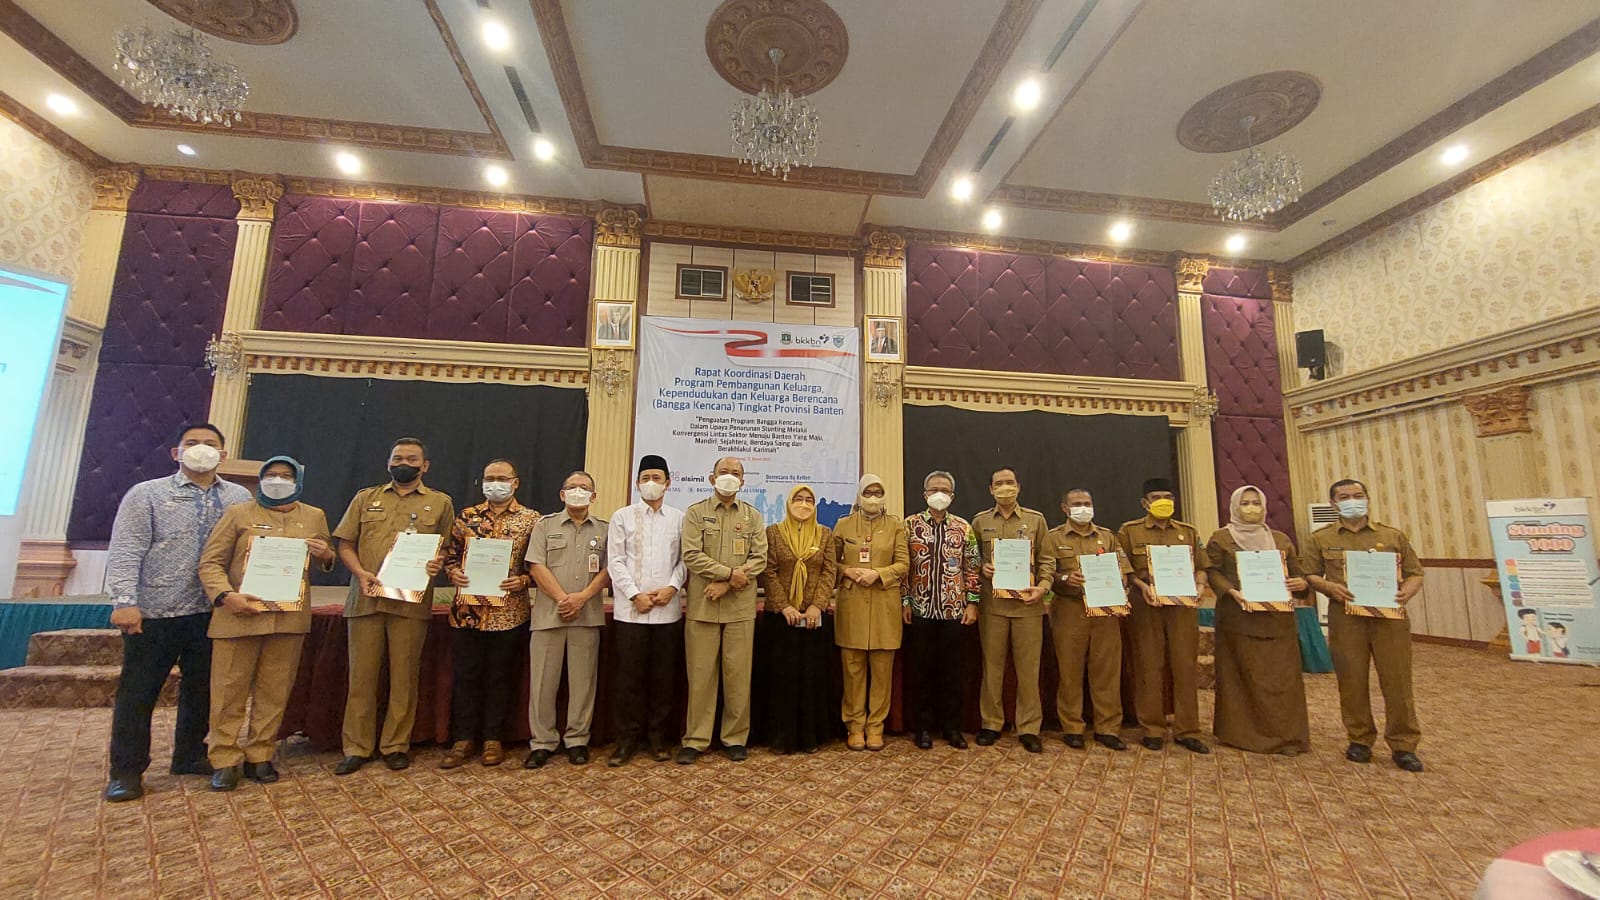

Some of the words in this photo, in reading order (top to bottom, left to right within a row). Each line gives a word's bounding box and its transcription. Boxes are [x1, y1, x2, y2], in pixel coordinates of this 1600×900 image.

[796, 336, 821, 345] bkkbn
[695, 367, 721, 379] Rapat
[724, 368, 772, 380] Koordinasi
[774, 371, 806, 381] Daerah
[674, 377, 714, 389] Program
[717, 379, 780, 391] Pembangunan
[783, 382, 824, 394] Keluarga,
[659, 388, 728, 400] Kependudukan
[731, 391, 748, 401] dan
[750, 391, 790, 403] Keluarga
[792, 394, 838, 404] Berencana
[652, 399, 690, 411] (Bangga
[693, 400, 735, 412] Kencana)
[738, 402, 772, 415] Tingkat
[775, 404, 811, 414] Provinsi
[813, 405, 844, 415] Banten
[731, 417, 755, 425] Program
[750, 439, 773, 447] Berdaya
